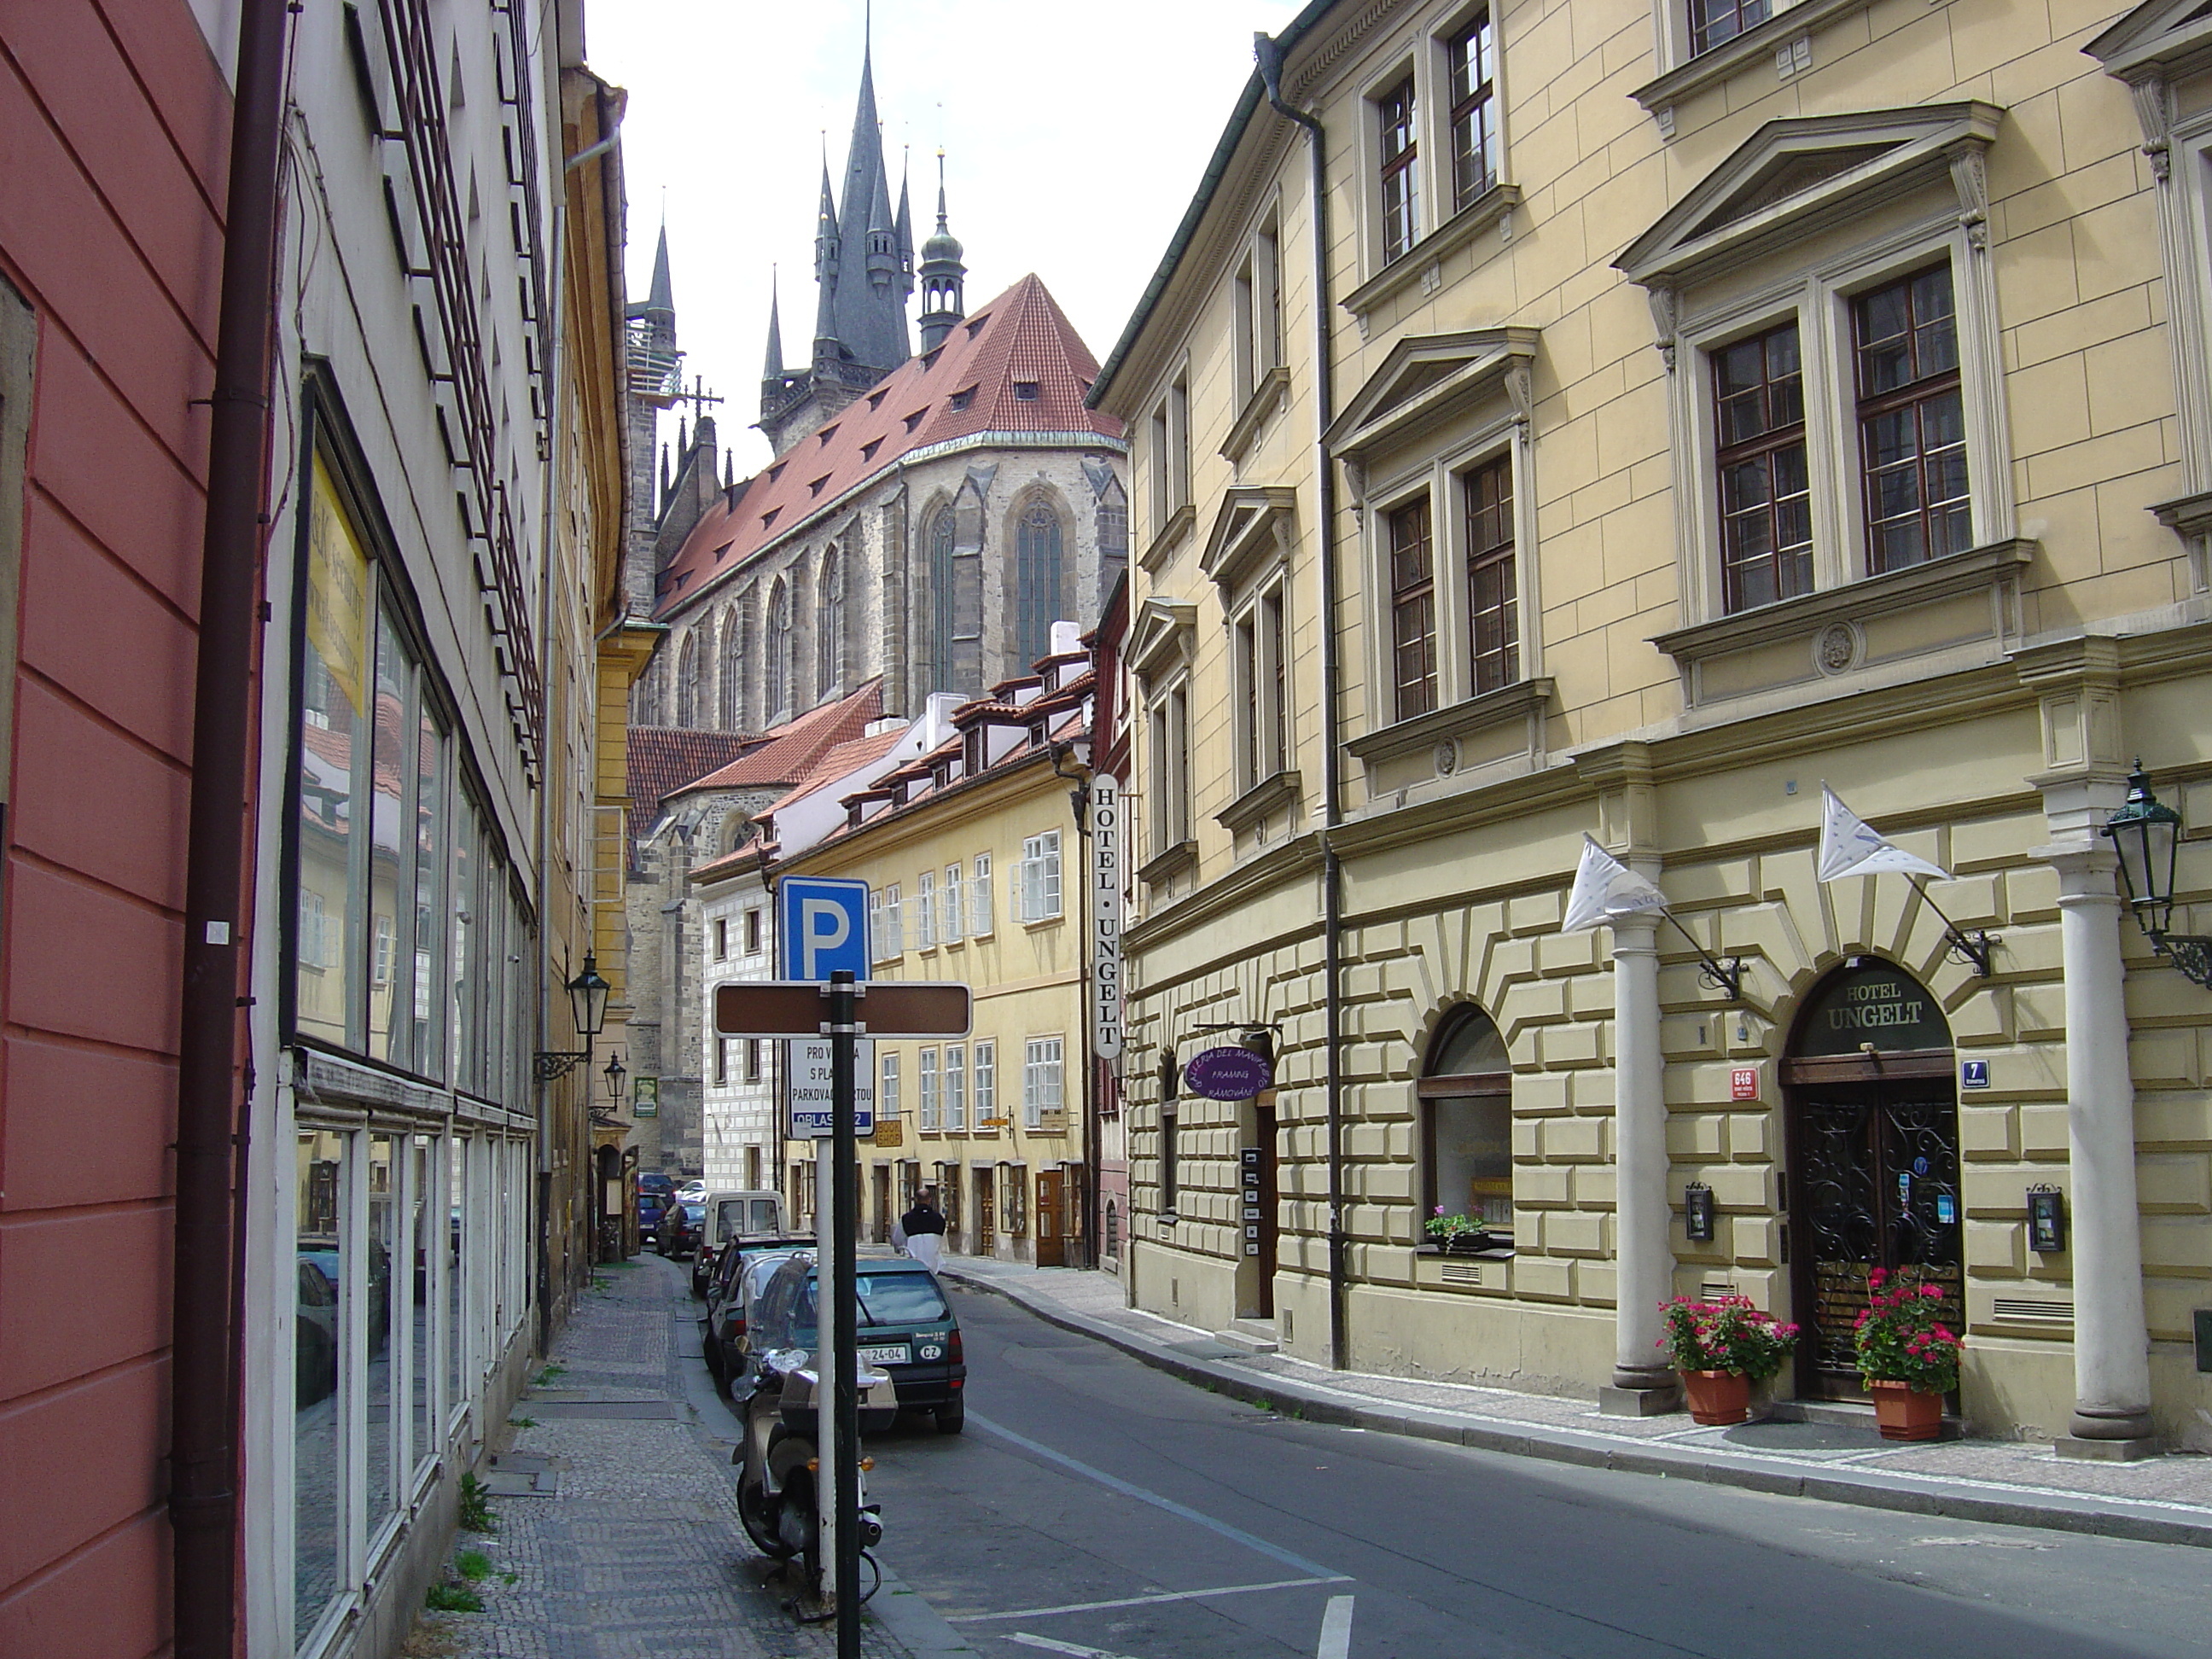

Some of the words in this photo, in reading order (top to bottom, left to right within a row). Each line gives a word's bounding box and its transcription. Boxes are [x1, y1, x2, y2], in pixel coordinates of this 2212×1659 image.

[1096, 789, 1115, 890] HOTEL
[802, 899, 850, 979] P
[1098, 918, 1116, 1045] UNGELT
[1846, 982, 1901, 1001] HOTEL
[1827, 1001, 1923, 1030] UNGELT
[806, 1046, 824, 1059] PRO
[810, 1068, 817, 1080] S
[1970, 1063, 1978, 1079] 7
[1735, 1072, 1751, 1086] 646
[878, 1122, 900, 1133] BOOK
[878, 1133, 900, 1145] SHOP
[871, 1348, 901, 1360] 24-04
[923, 1347, 937, 1358] CZ
